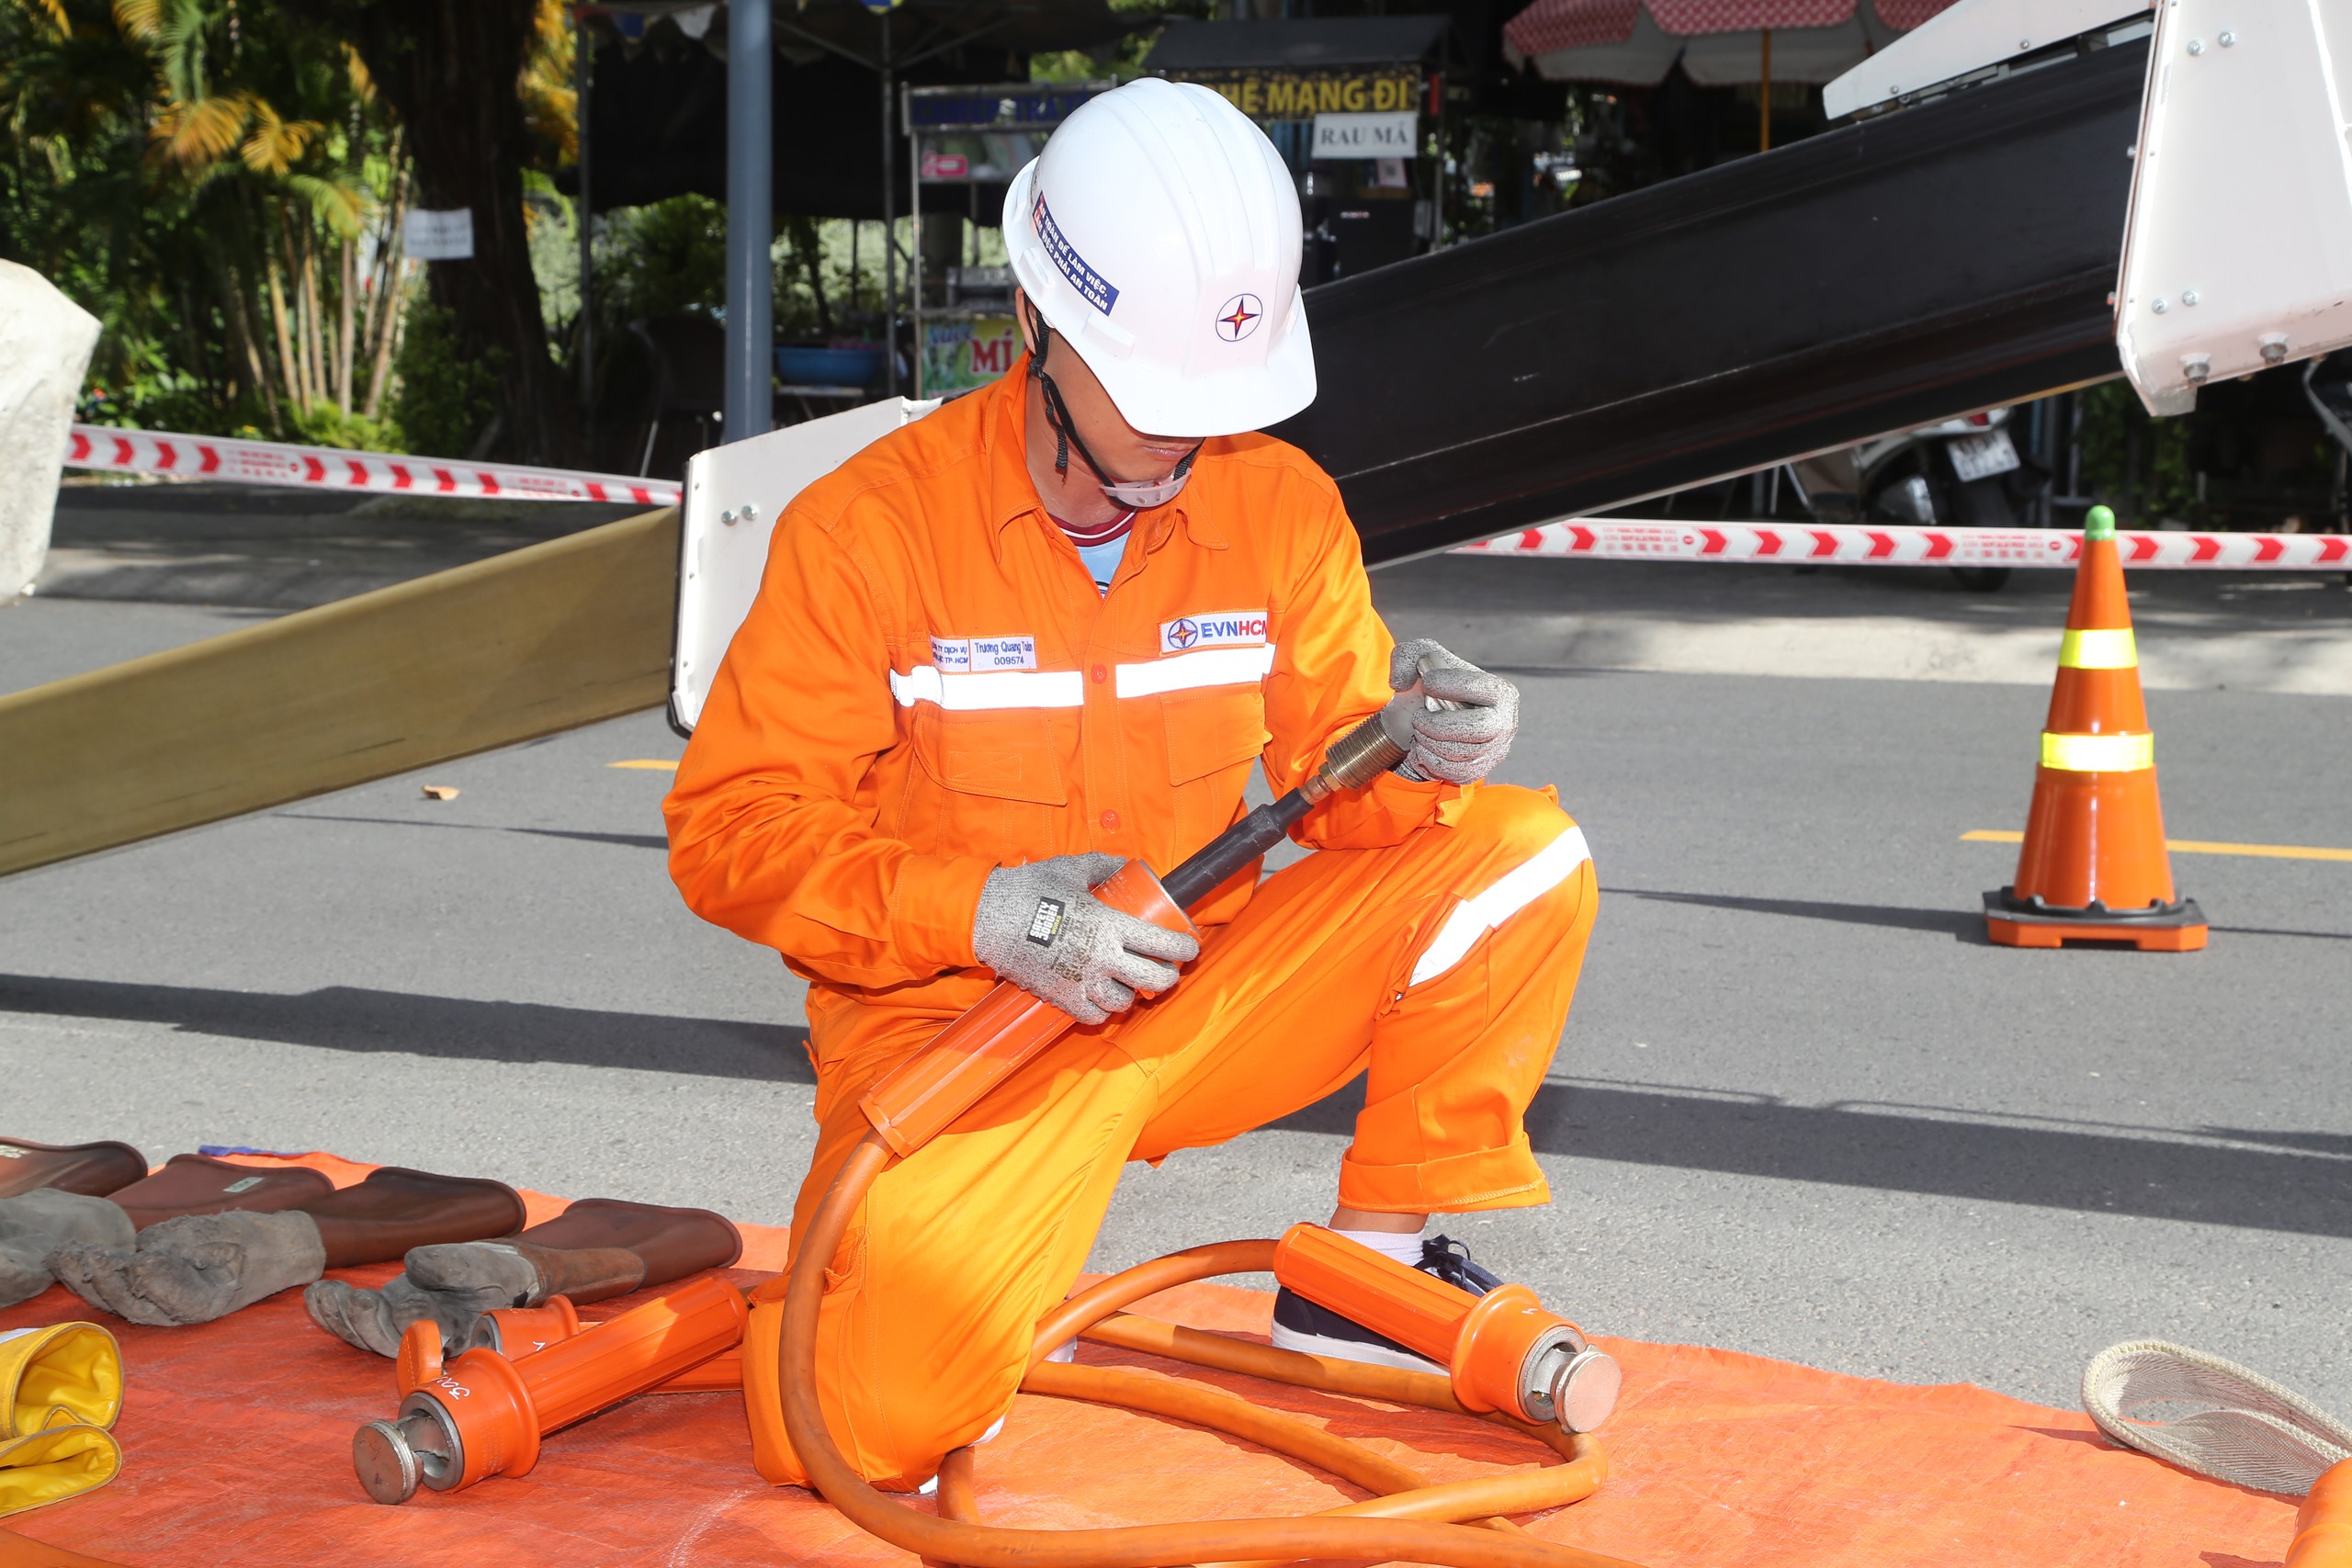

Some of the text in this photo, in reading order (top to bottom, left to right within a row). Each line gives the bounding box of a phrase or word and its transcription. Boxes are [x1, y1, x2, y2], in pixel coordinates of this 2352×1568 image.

[1267, 79, 1365, 112] MANG
[1374, 79, 1408, 111] ĐI
[1320, 127, 1366, 145] RAU
[1041, 229, 1055, 254] VIỆC
[1069, 273, 1083, 289] AN
[1083, 285, 1109, 310] TOÀN
[1045, 215, 1059, 243] TOÀN
[1068, 253, 1085, 275] LÀM
[1086, 271, 1108, 298] VIỆC,
[1001, 641, 1021, 654] Quang
[1030, 901, 1049, 938] SAFETY
[1039, 904, 1060, 942] JOGGER
[1051, 915, 1062, 935] WORKS
